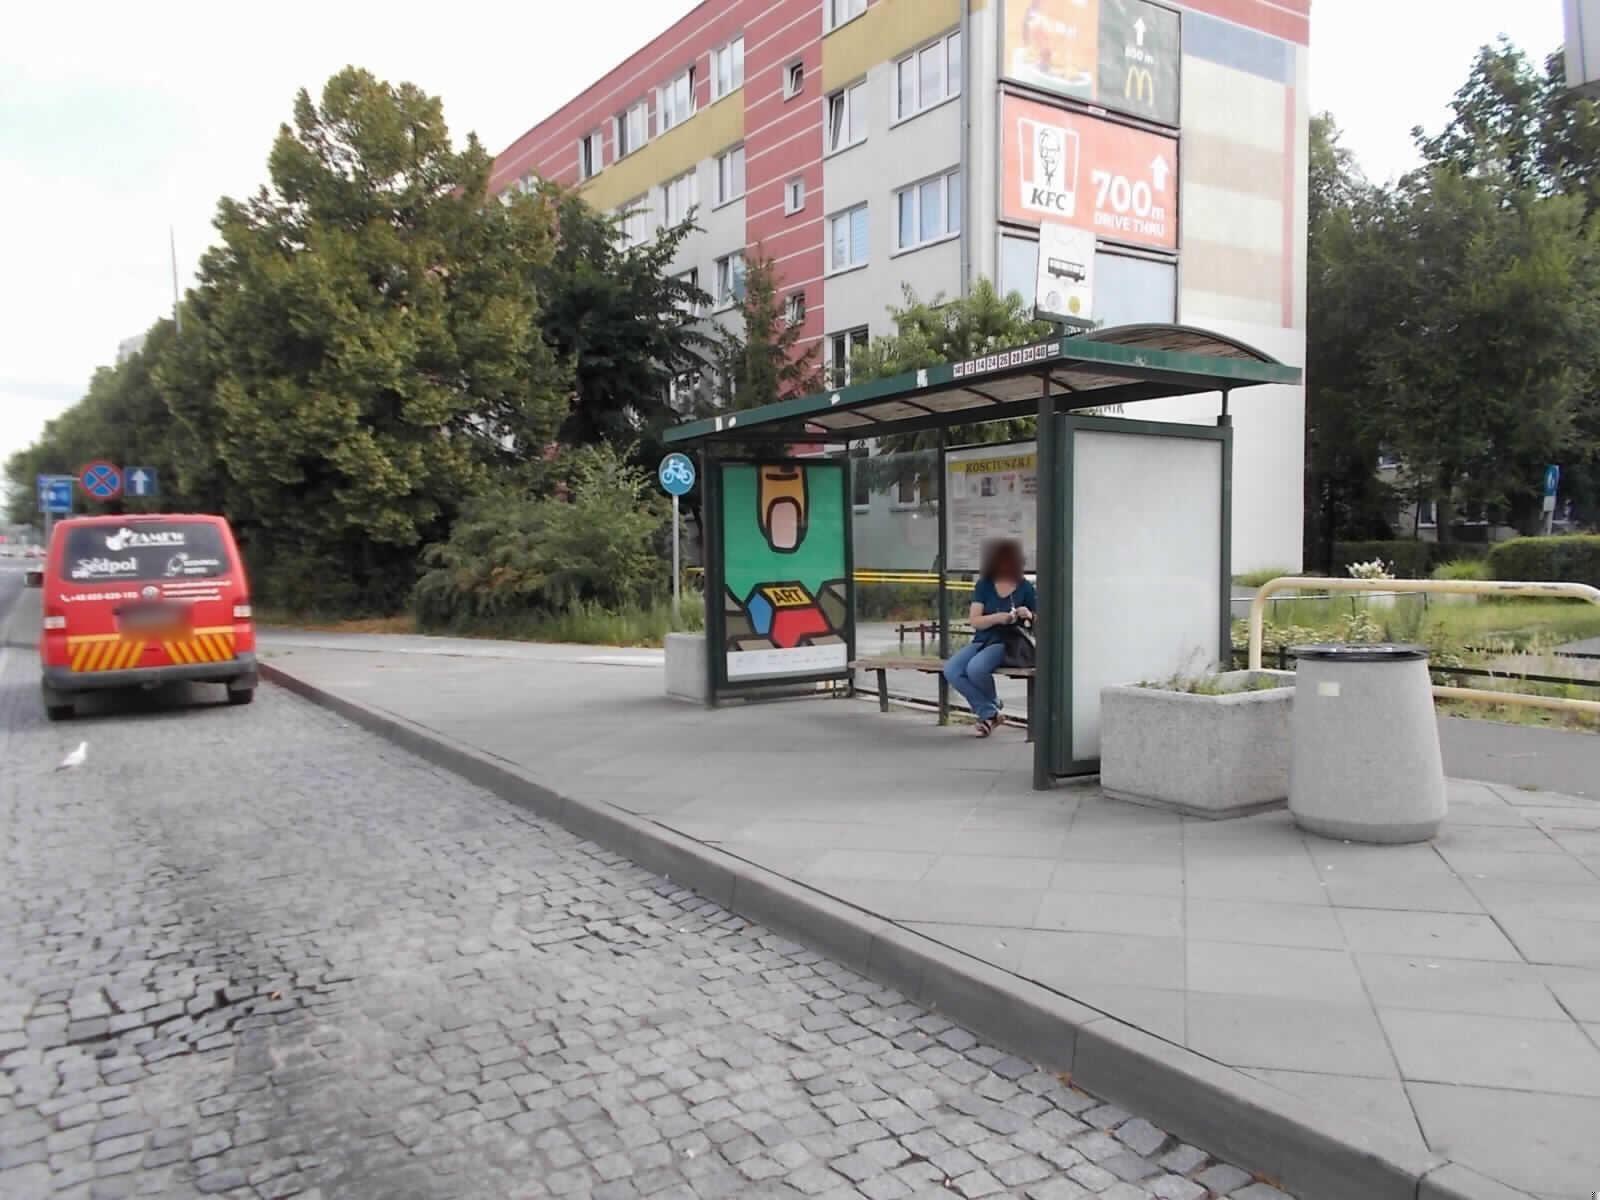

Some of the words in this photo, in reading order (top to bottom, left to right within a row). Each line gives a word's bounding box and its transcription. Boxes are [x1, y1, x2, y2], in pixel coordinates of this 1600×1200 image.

[1030, 187, 1067, 211] KFC
[1094, 212, 1131, 233] DRIVE
[770, 589, 804, 604] ART
